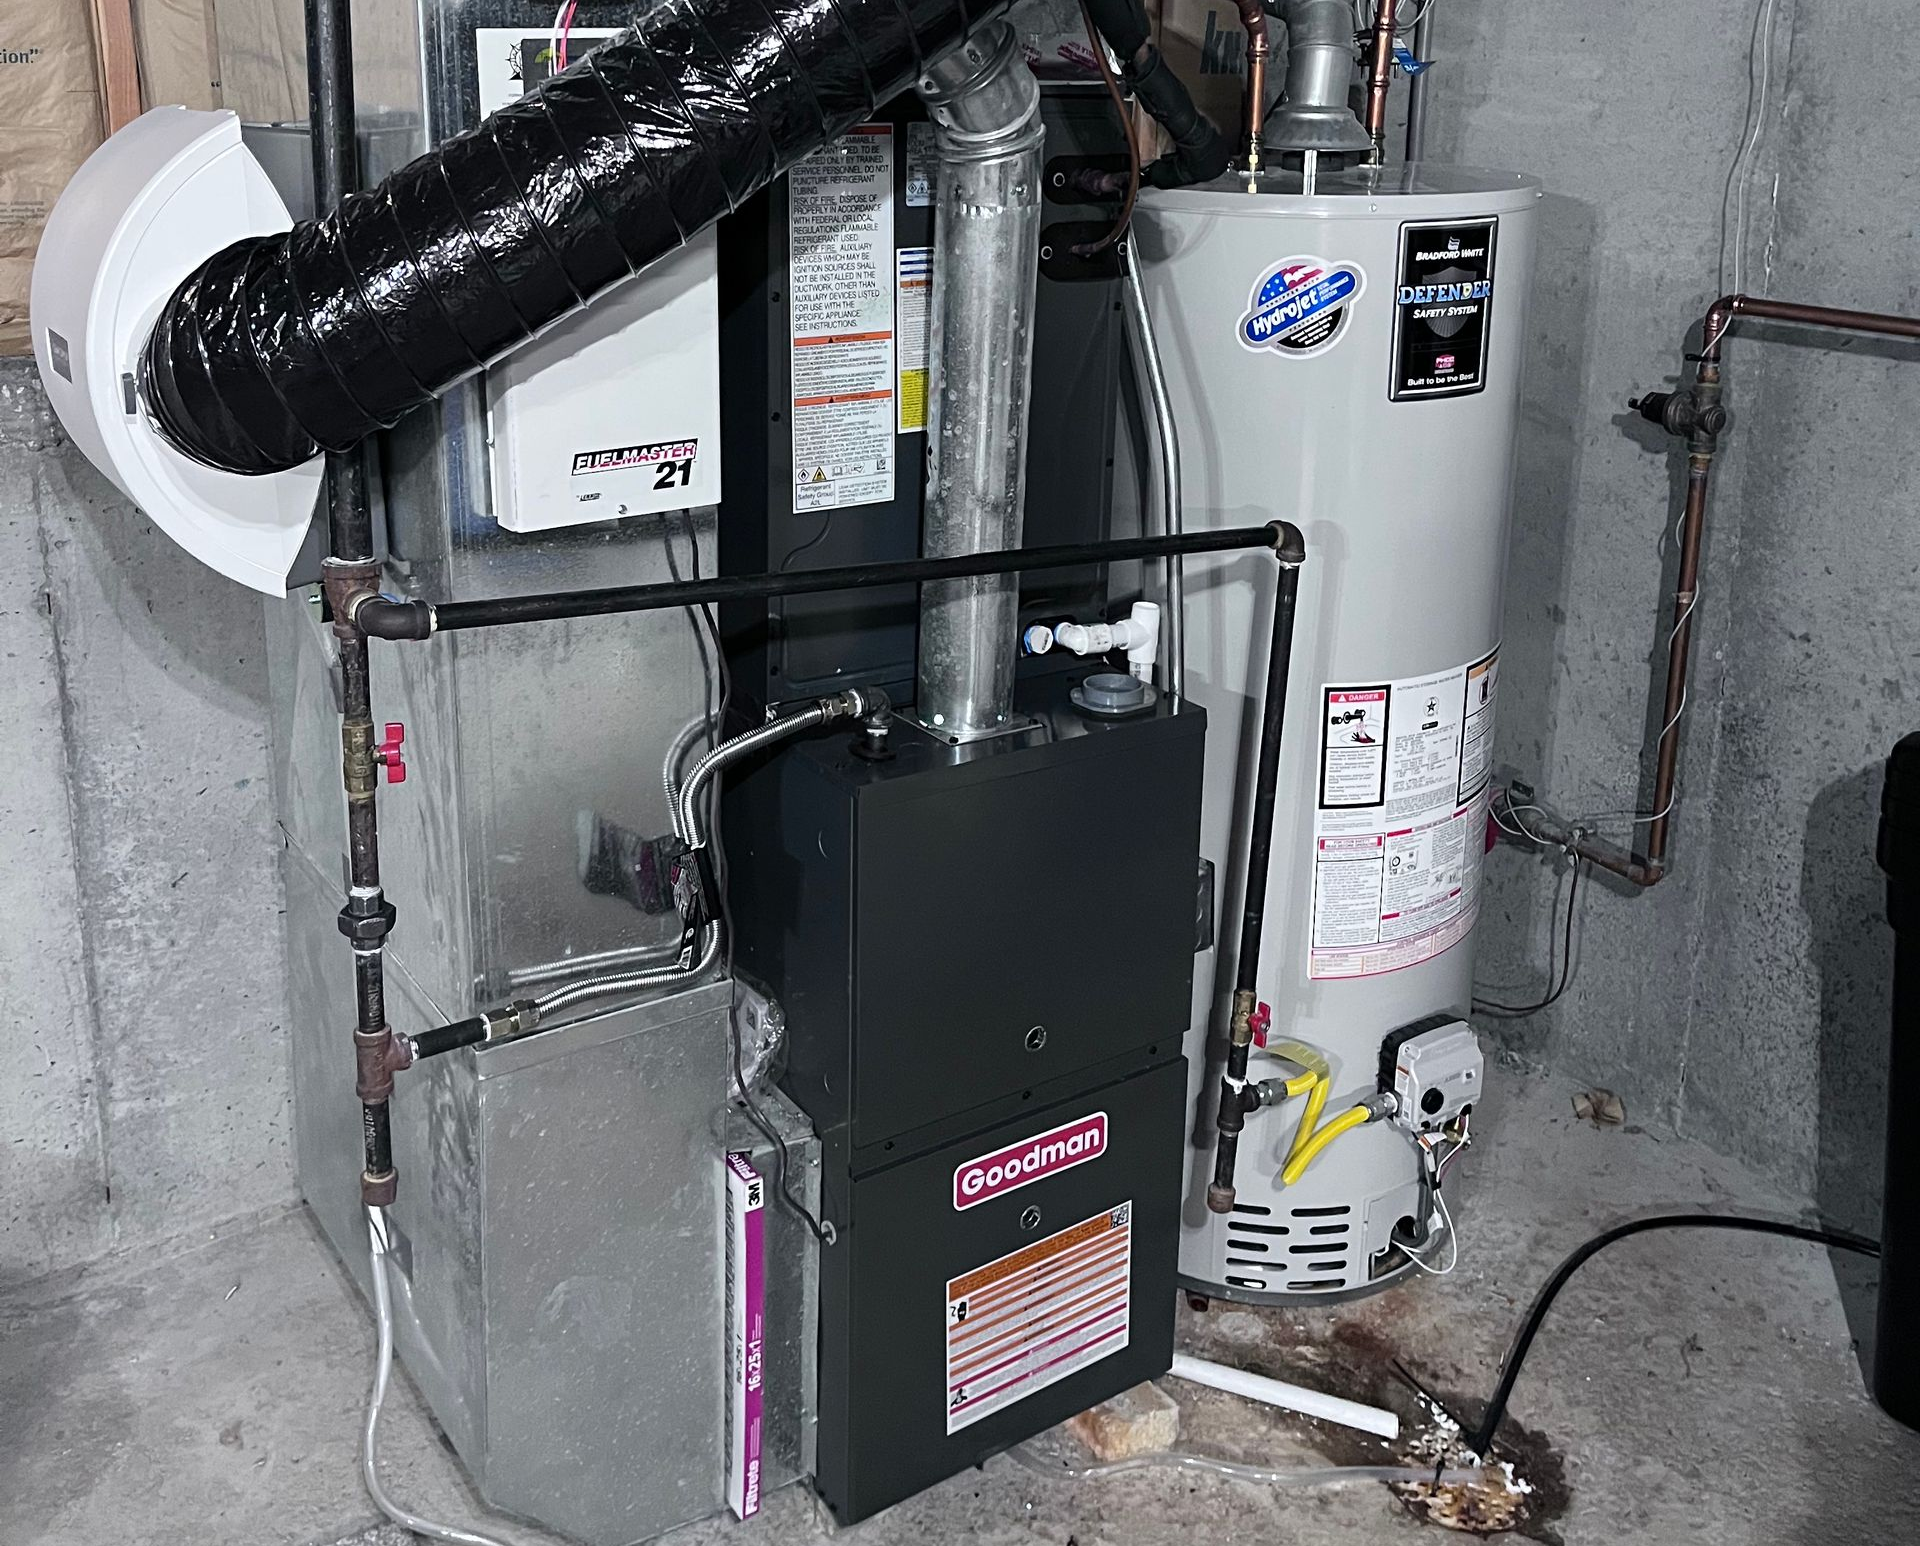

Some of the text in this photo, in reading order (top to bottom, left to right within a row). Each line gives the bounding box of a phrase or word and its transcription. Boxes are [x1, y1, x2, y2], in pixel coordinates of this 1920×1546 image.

[871, 145, 879, 153] BE
[827, 156, 844, 165] ONLY
[855, 155, 884, 163] TRAINED
[792, 167, 820, 175] SERVICE
[864, 165, 874, 173] DO
[792, 175, 875, 185] PUNCTURE REFRIGERANT
[793, 197, 808, 205] RISK
[810, 196, 819, 204] OF
[840, 194, 867, 203] DISPOSE
[869, 194, 877, 202] OF
[794, 204, 882, 215] PROPERLY IN ACCORDANCE
[793, 214, 874, 224] WITH FEDERAL OR LOCAL
[794, 223, 879, 234] REGULATIONS FLAMMABLE
[794, 235, 839, 244] REFRIGERANT
[793, 245, 808, 254] RISK
[810, 245, 819, 254] OF
[840, 243, 872, 251] AUXILIARY
[794, 252, 870, 264] DEVICES WHICH MAY BE
[1416, 248, 1484, 261] BRADFORD WHITE
[794, 262, 876, 274] IGNITION SOURCES SHALL
[794, 275, 808, 284] NOT
[820, 272, 854, 281] INSTALLED
[856, 272, 862, 280] IN
[863, 271, 876, 279] THE
[835, 282, 857, 291] OTHER
[859, 281, 876, 289] THAN
[795, 290, 880, 302] AUXILIARY DEVICES LISTED
[1398, 280, 1490, 304] DEFENDER
[795, 301, 855, 312] FOR USE WITH THE
[1252, 288, 1318, 336] Hydrojet
[1413, 305, 1478, 319] SAFETY SYSTEM
[795, 312, 824, 322] SPECIFIC
[795, 323, 808, 331] SEE
[1407, 378, 1425, 386] Built
[1447, 374, 1458, 382] the
[1459, 372, 1474, 381] Best
[575, 441, 697, 471] FUELMASTER
[653, 459, 692, 490] 21
[800, 483, 832, 492] Refrigerant
[1348, 693, 1379, 702] DANGER
[961, 1127, 1100, 1196] Goodman
[748, 1182, 760, 1206] 3M
[748, 1339, 761, 1392] 16x25x1
[745, 1459, 759, 1516] Filtrete
